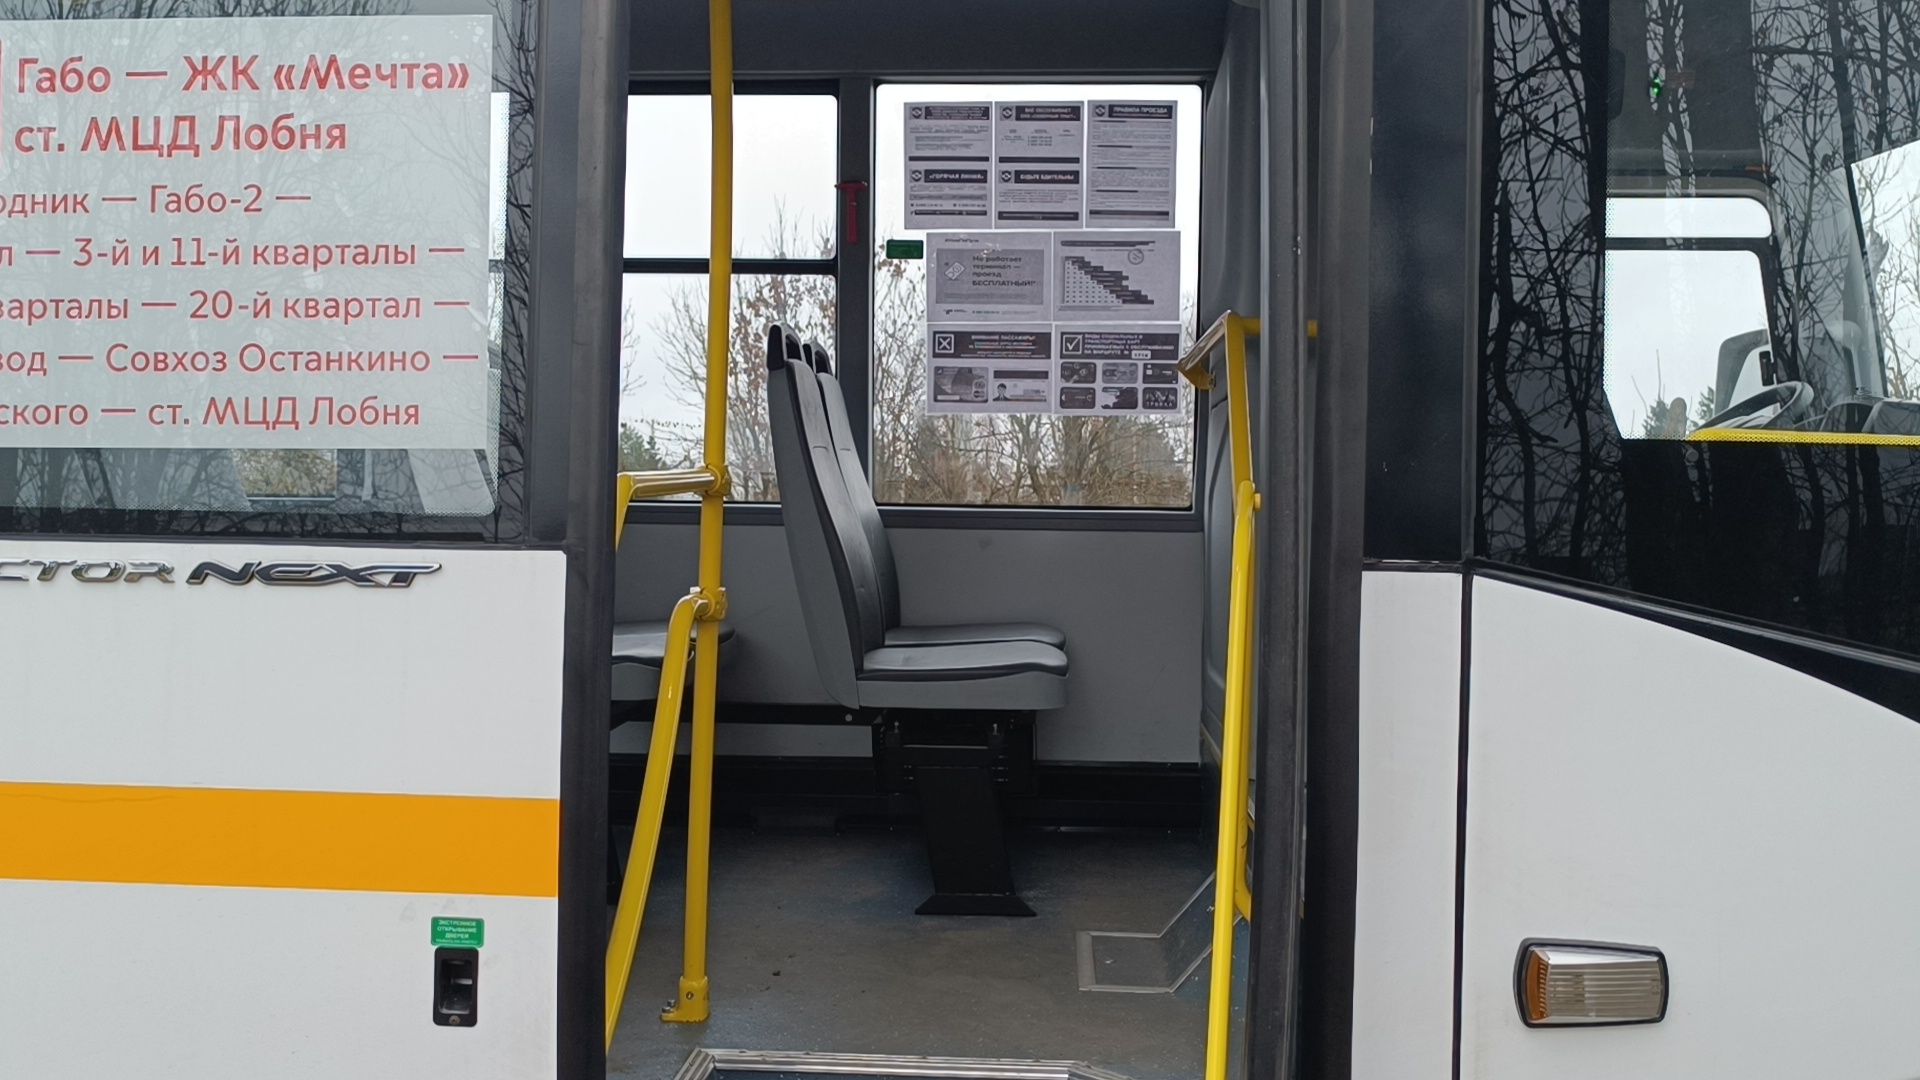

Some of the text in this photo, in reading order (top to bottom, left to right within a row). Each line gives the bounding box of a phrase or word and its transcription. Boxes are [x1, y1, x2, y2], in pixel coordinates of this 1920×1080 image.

[17, 57, 111, 94] Габо
[182, 55, 261, 92] ЖК
[274, 55, 470, 92] «Мечта»
[14, 113, 347, 157] ст. МЦД Лобня
[149, 184, 263, 215] Габо-2
[73, 237, 130, 267] 3-й
[142, 244, 161, 266] и
[170, 236, 241, 266] 11-й
[253, 242, 416, 271] кварталы
[0, 297, 129, 325] арталы
[189, 290, 271, 320] 20-й
[283, 296, 422, 325] квартал
[0, 351, 47, 376] од
[106, 343, 228, 374] Совхоз
[239, 343, 431, 373] Останкино
[148, 402, 190, 426] ст.
[203, 396, 300, 431] МЦД
[309, 396, 421, 426] Лобня
[185, 559, 443, 588] NEXT
